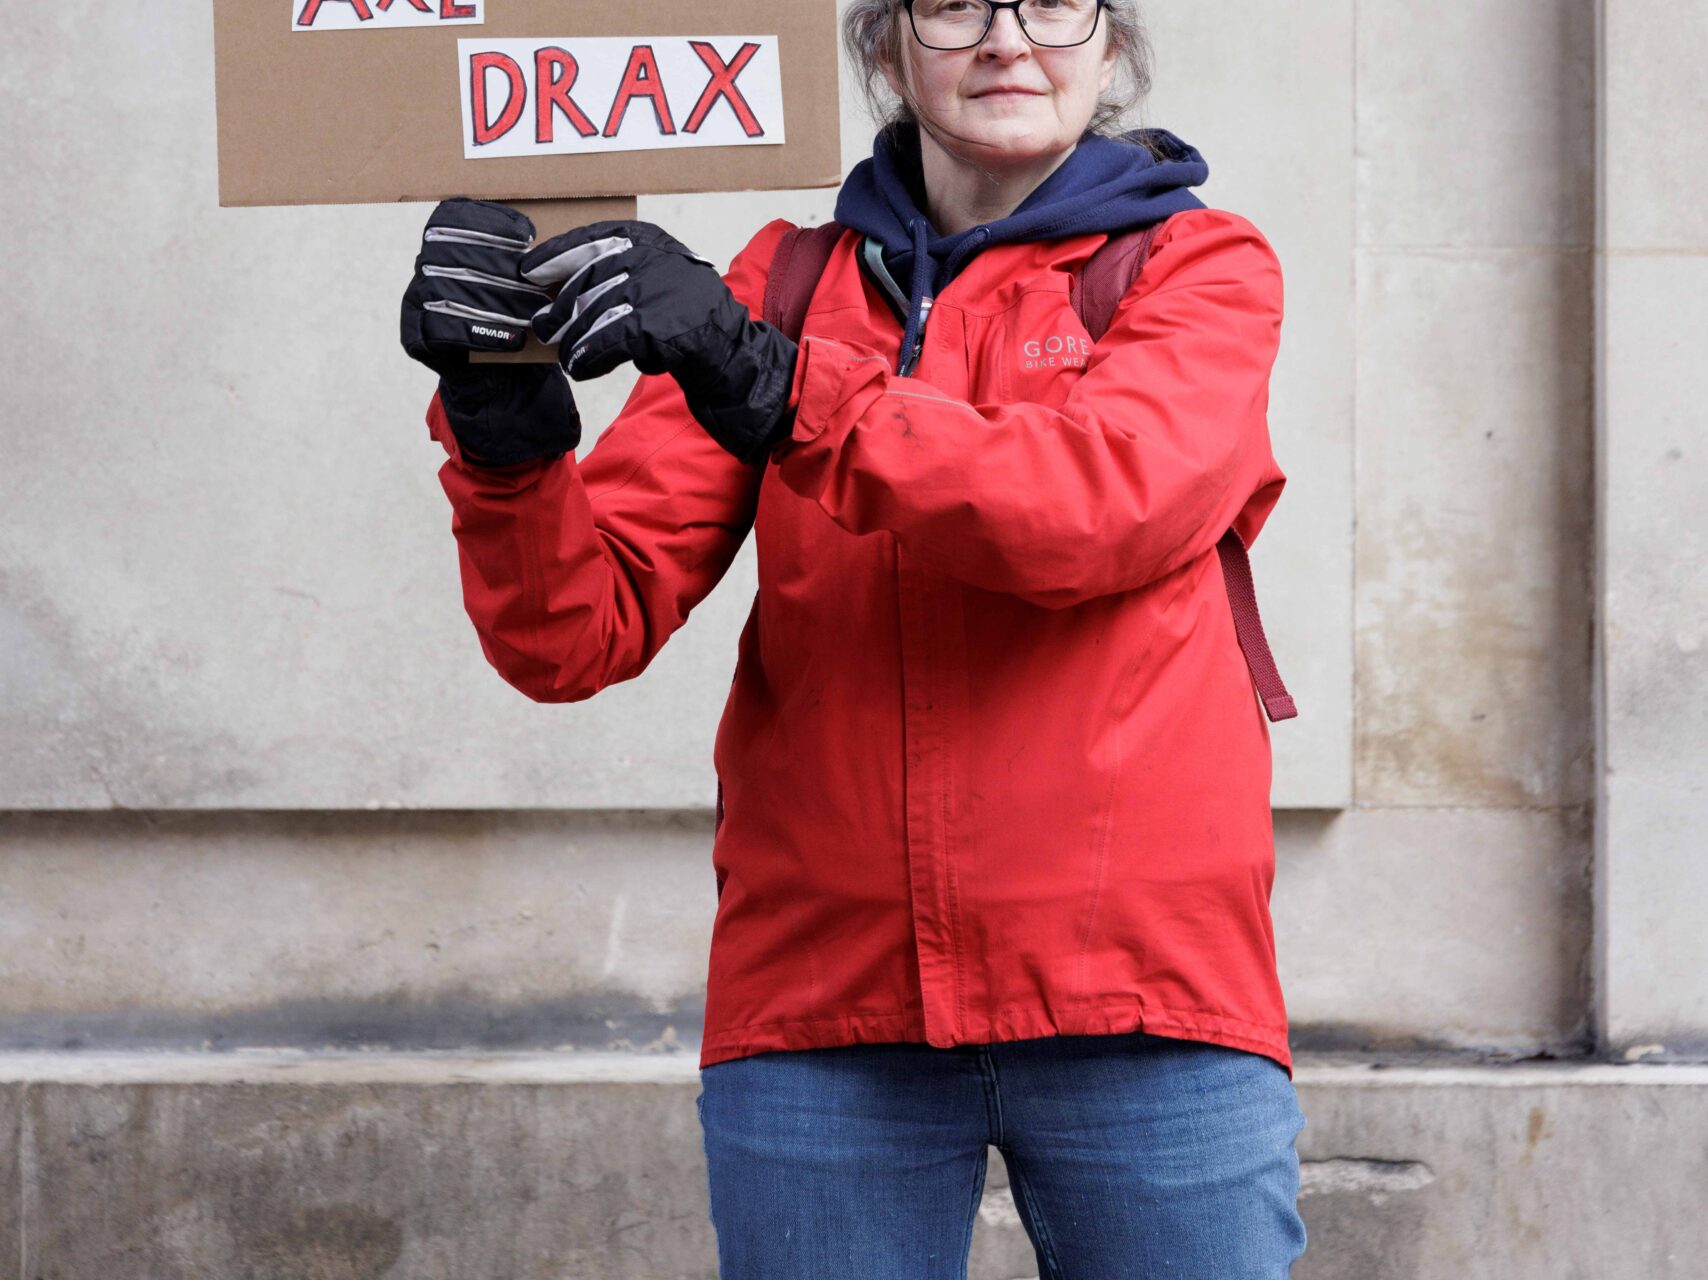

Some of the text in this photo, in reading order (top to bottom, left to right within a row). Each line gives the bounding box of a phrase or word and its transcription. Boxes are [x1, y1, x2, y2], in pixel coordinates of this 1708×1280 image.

[469, 40, 766, 147] DRAX
[471, 325, 516, 341] NOVADRY
[1023, 335, 1090, 357] GORE
[1025, 356, 1087, 369] BIKE WEA
